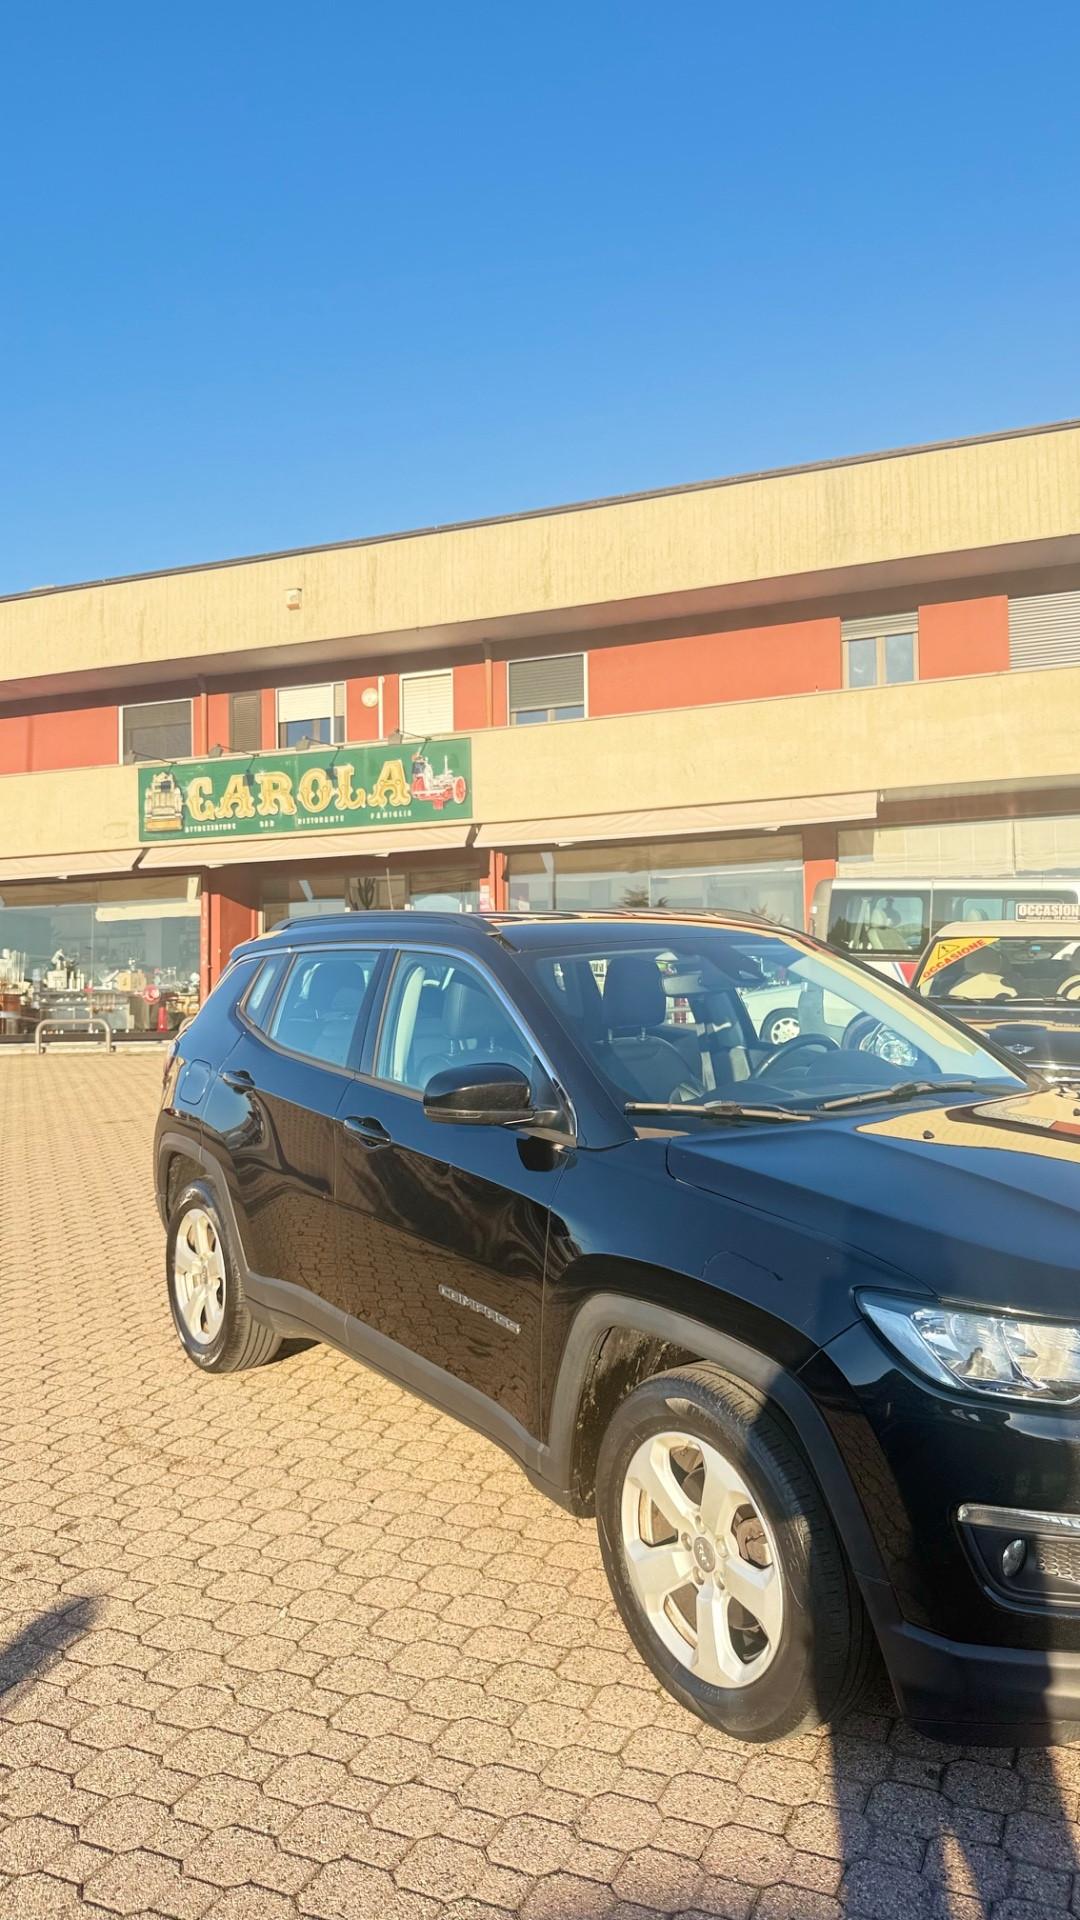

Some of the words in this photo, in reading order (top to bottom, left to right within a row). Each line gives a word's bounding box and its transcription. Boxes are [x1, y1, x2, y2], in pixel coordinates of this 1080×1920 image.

[187, 759, 411, 821] CAROLA
[259, 820, 275, 828] BAR
[297, 815, 345, 825] RISTORANTE
[370, 810, 412, 820] FAMIGLIA
[922, 939, 986, 979] OCCASIONE
[438, 1283, 521, 1335] COMPASS
